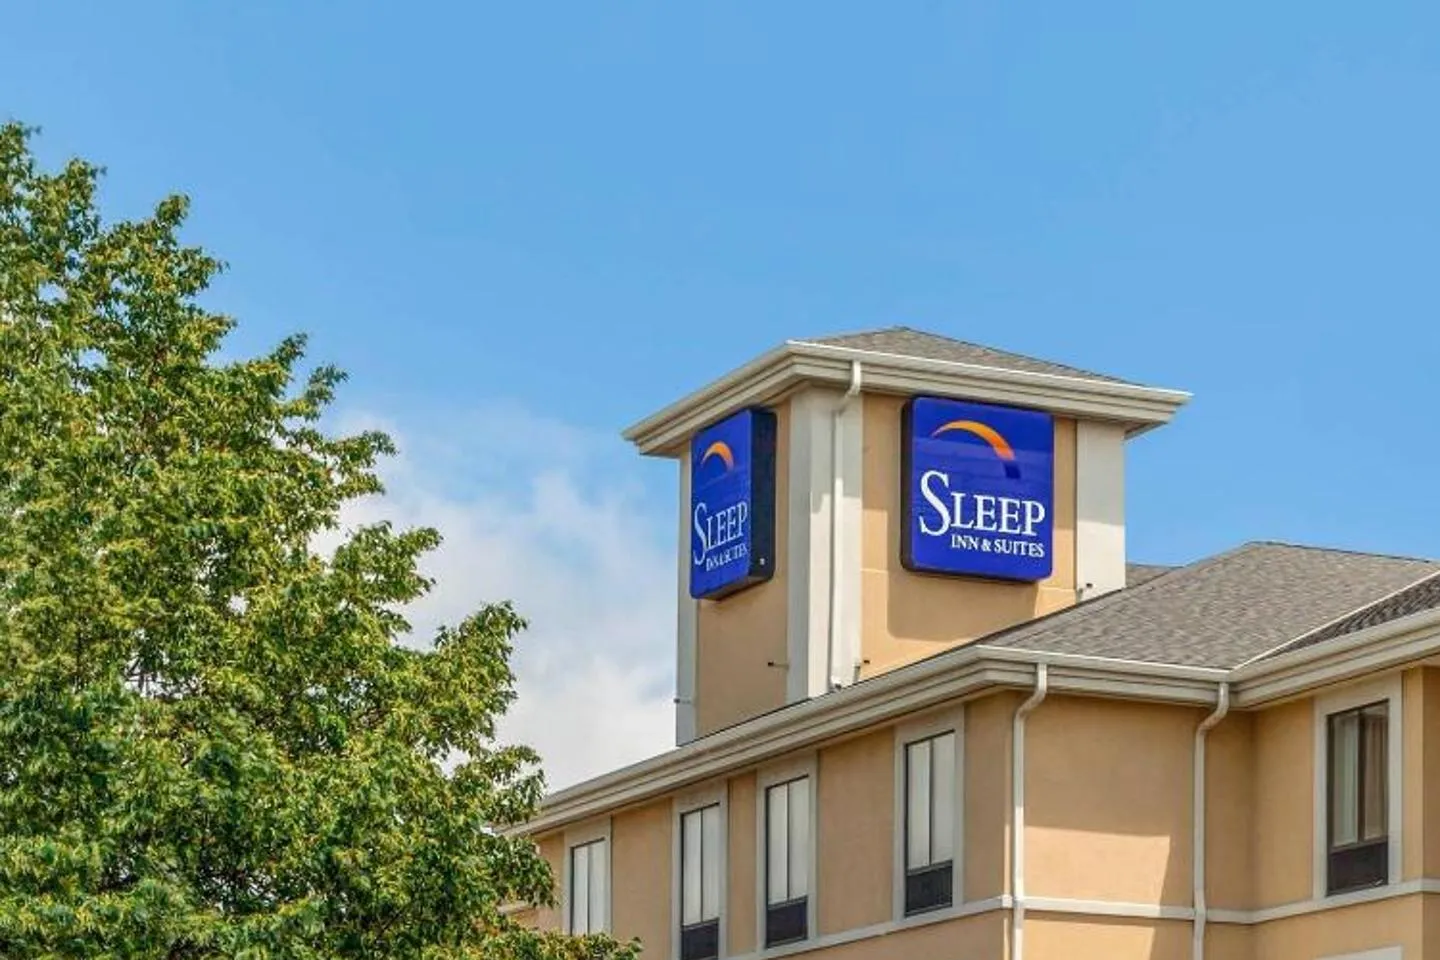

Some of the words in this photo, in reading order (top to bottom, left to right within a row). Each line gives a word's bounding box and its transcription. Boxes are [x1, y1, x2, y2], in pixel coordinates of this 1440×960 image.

[693, 501, 748, 565] SLEEP
[918, 470, 1045, 536] SLEEP
[951, 534, 979, 550] INN
[980, 538, 991, 552] &
[994, 538, 1045, 558] SUITES
